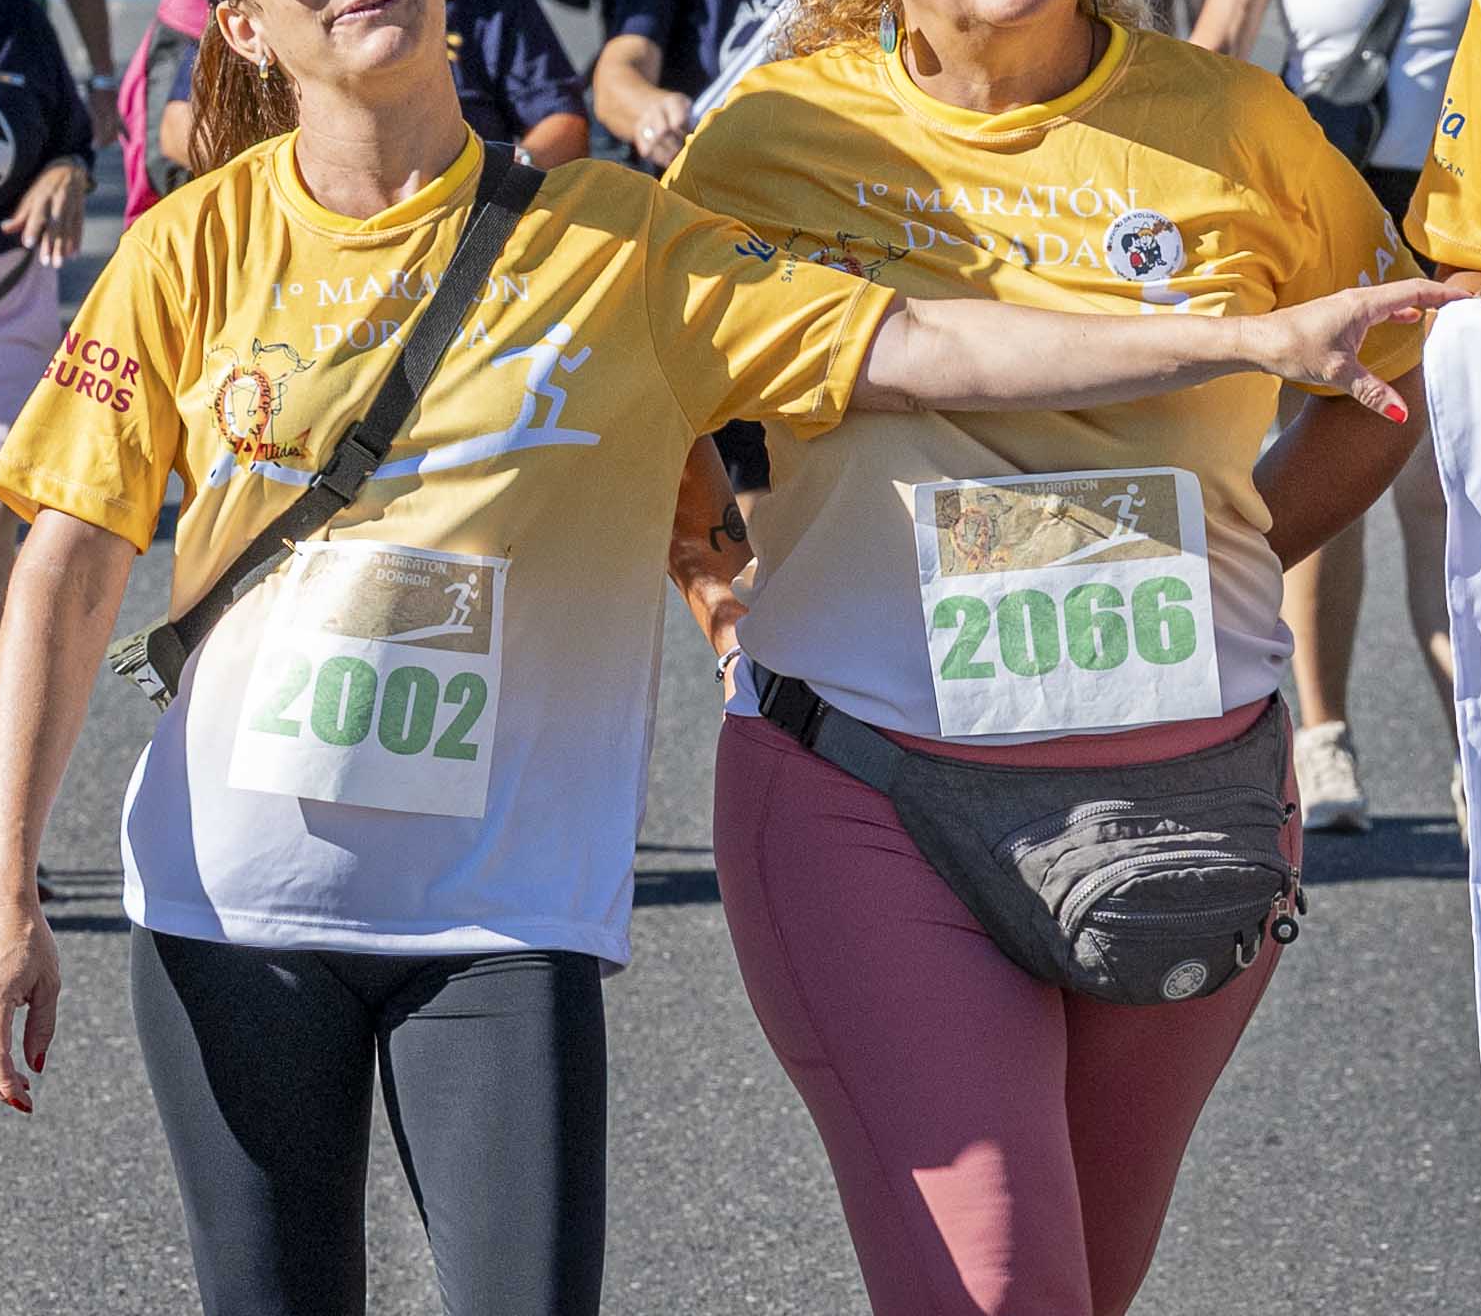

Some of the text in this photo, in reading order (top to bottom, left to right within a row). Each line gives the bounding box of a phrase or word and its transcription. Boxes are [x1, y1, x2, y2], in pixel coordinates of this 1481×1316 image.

[1434, 154, 1465, 178] TAN
[904, 178, 1138, 219] MARATÓN
[316, 270, 530, 307] MARAN
[312, 317, 497, 353] DORA
[376, 569, 432, 588] DORADA
[933, 575, 1198, 681] 2066
[247, 648, 488, 761] 2002
